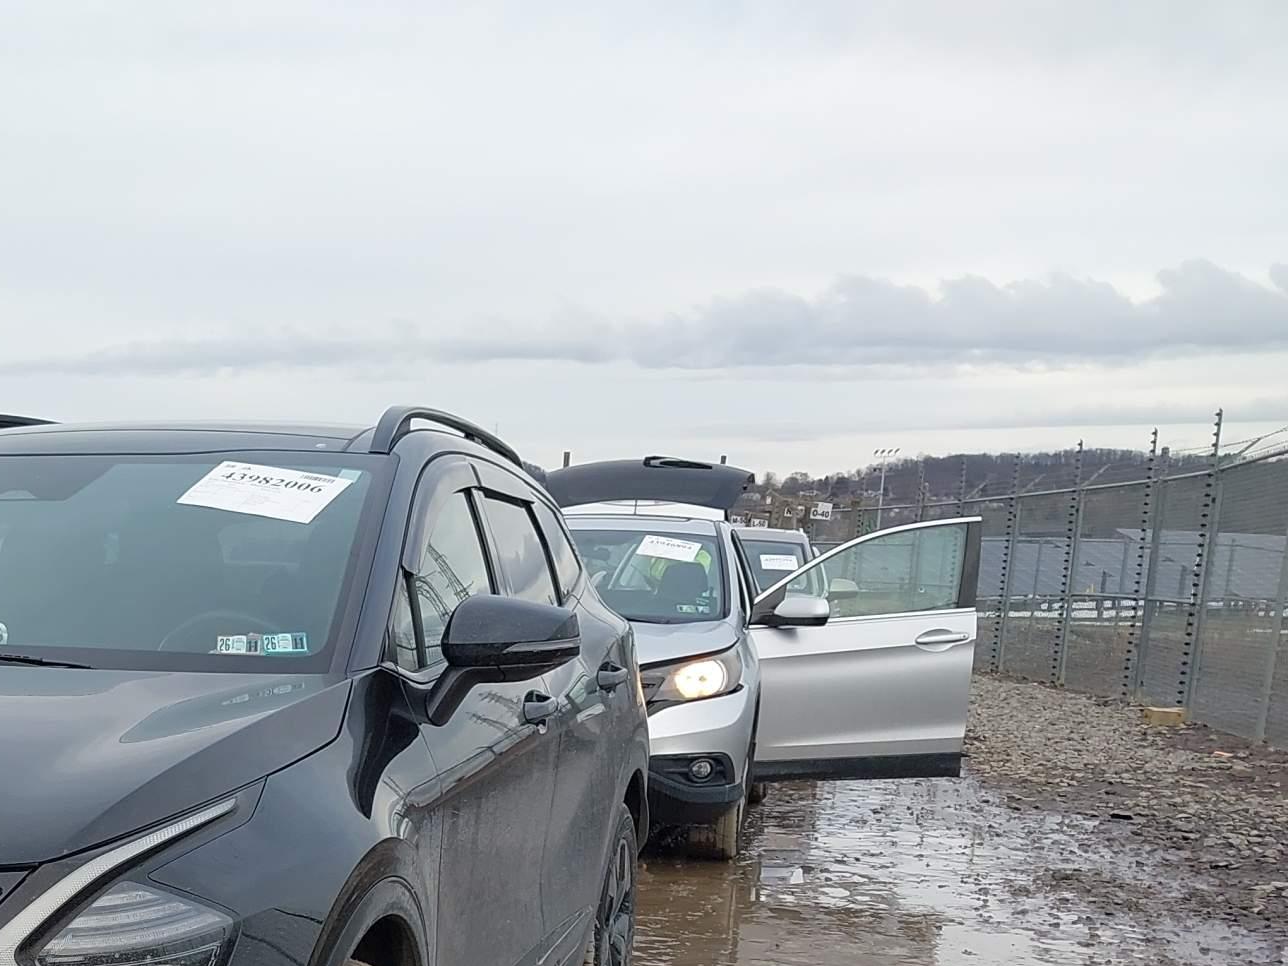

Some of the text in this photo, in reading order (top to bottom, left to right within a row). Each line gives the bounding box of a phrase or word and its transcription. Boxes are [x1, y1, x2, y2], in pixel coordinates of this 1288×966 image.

[221, 471, 324, 494] 43982006
[219, 638, 233, 652] 26
[264, 636, 277, 650] 26
